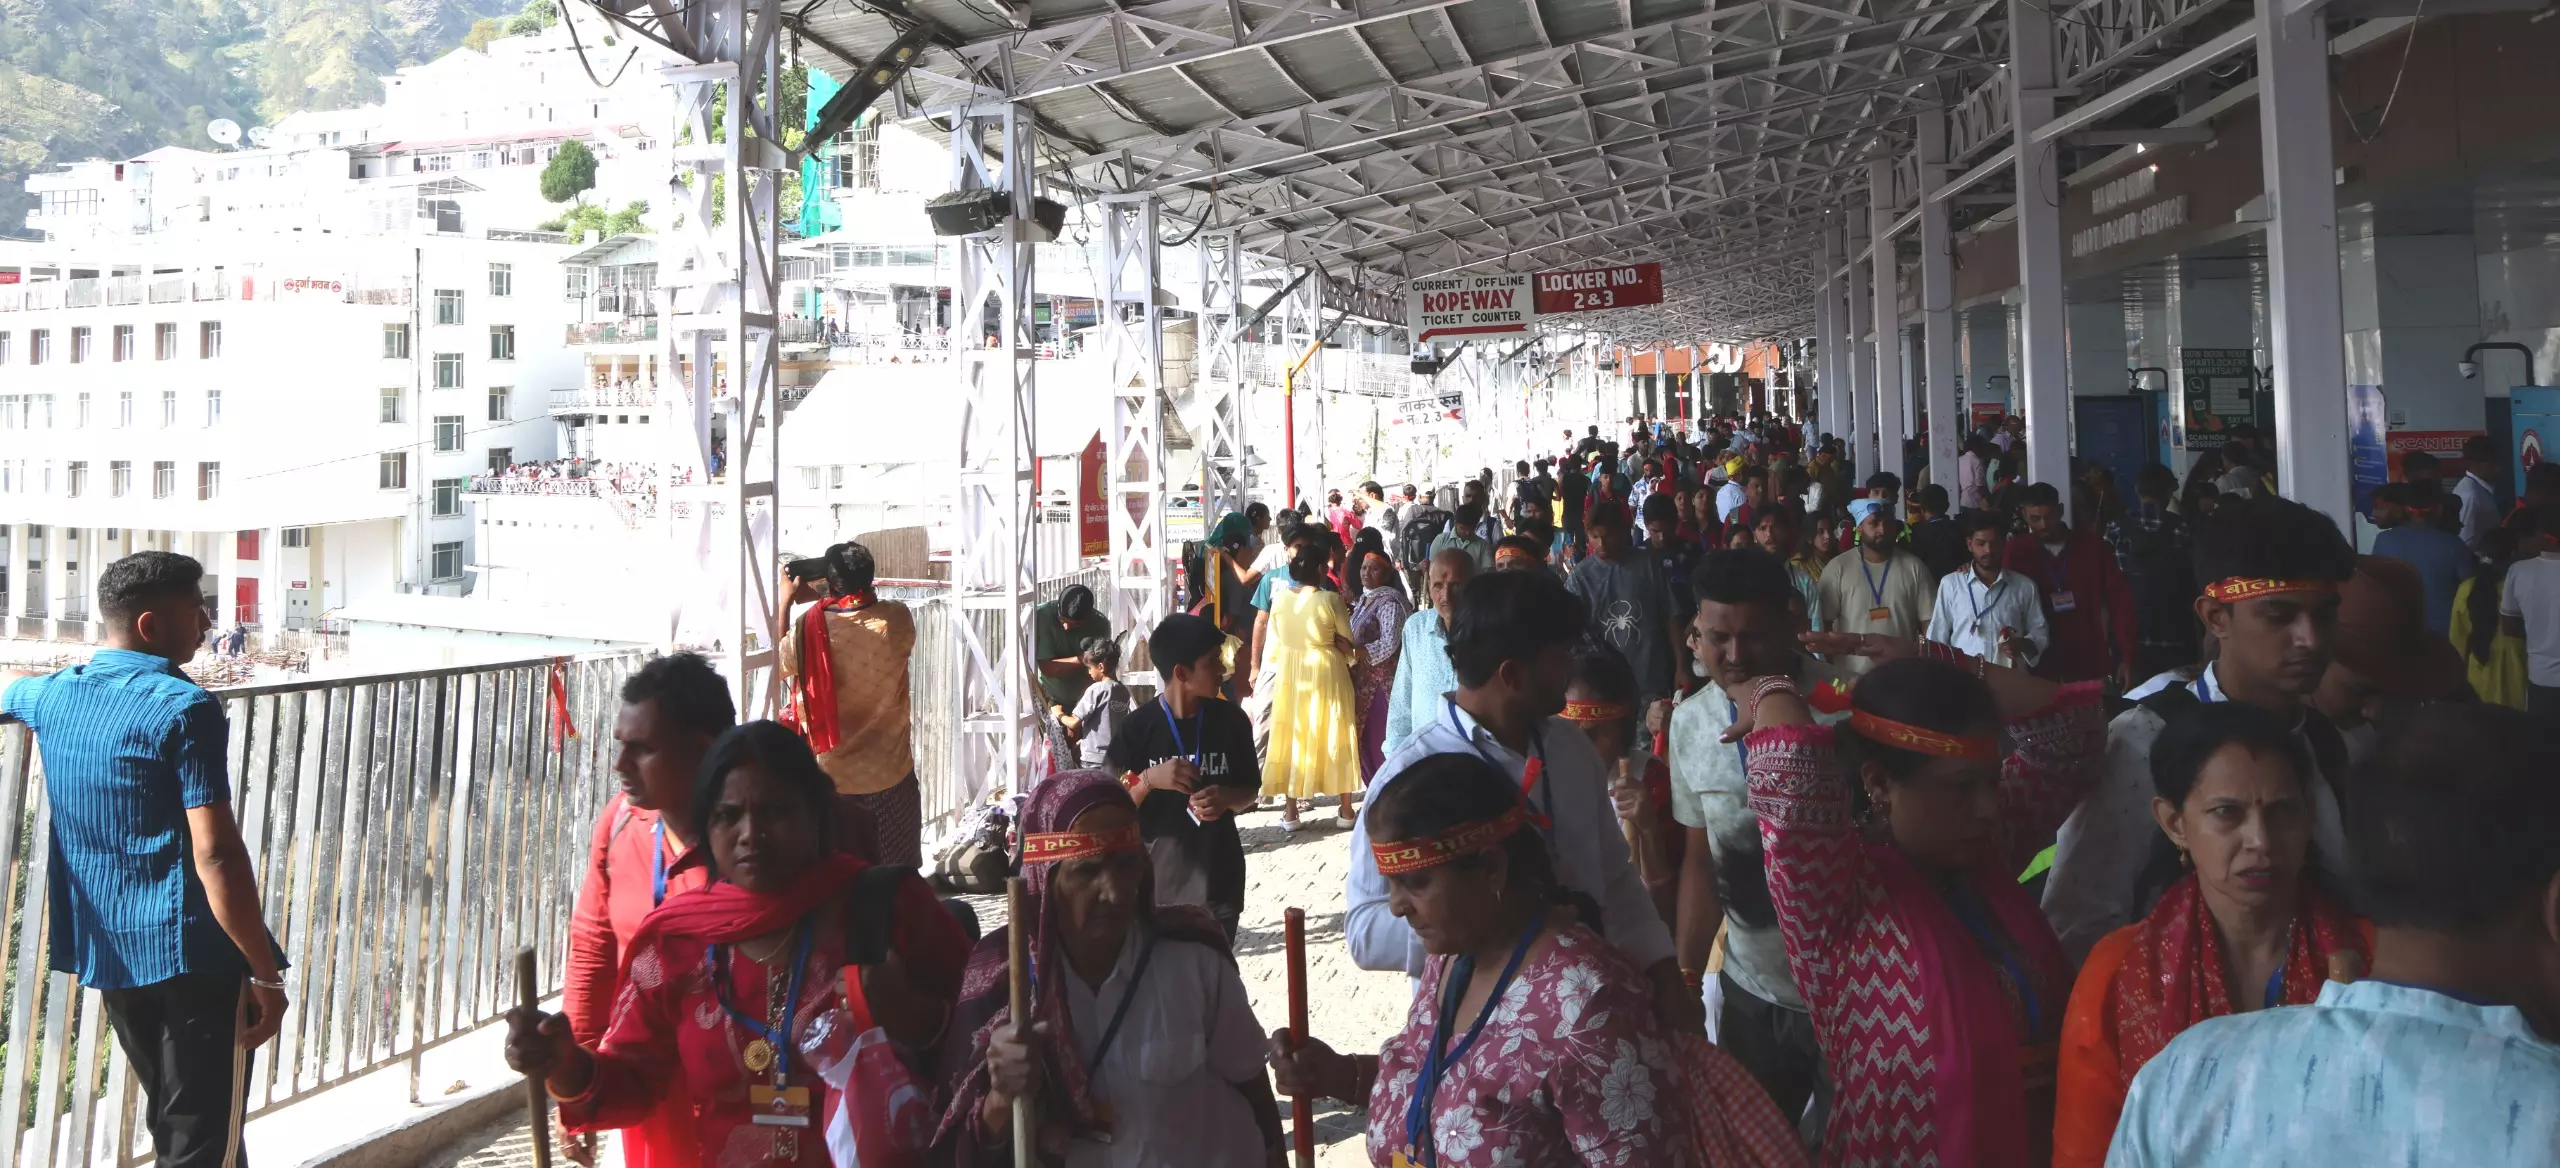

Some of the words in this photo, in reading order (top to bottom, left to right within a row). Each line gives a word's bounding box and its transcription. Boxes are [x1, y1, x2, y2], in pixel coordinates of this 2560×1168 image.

[1412, 278, 1463, 292] CURRENT
[1475, 275, 1525, 288] OFFLINE
[1540, 270, 1607, 293] LOCKER
[1612, 267, 1643, 287] NO.
[1423, 288, 1515, 313] ROPEWAY
[1422, 313, 1463, 326] TICKET
[1472, 311, 1522, 323] COUNTER
[2395, 437, 2439, 450] SCAN
[2441, 437, 2471, 450] HE
[1376, 846, 1421, 865] जय
